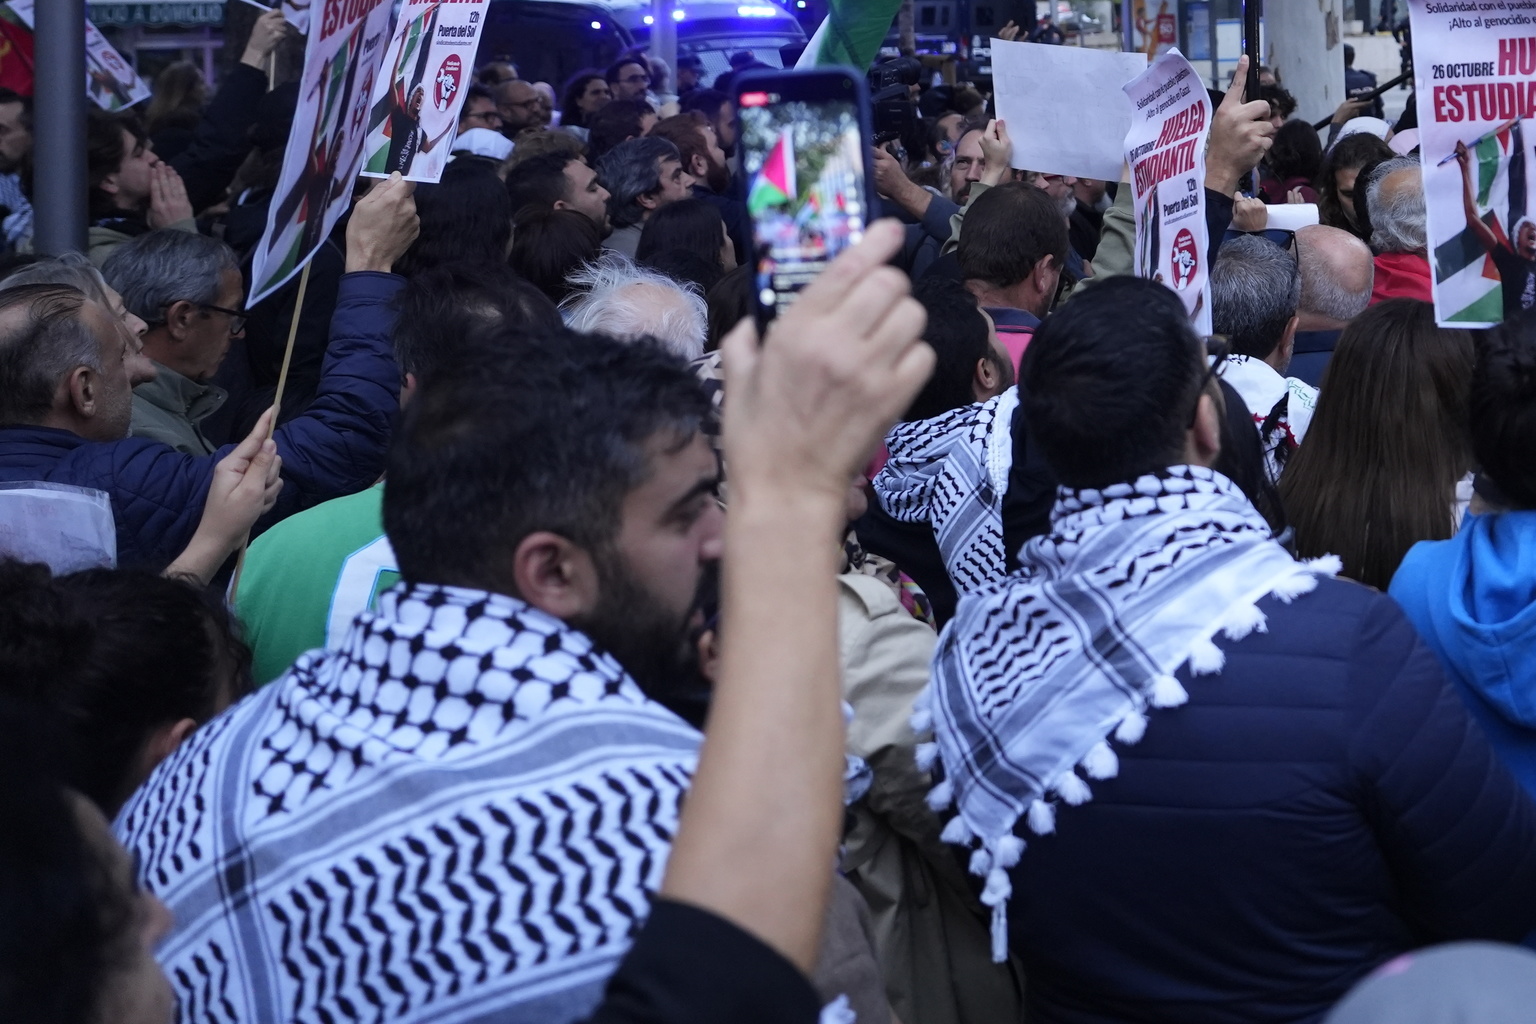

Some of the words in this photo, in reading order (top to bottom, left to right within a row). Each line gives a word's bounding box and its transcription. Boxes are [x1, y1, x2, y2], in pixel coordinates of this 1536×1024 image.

[1426, 1, 1477, 14] Solidaridad
[1479, 3, 1495, 12] con
[1498, 1, 1506, 10] el
[469, 11, 480, 23] 12h
[1449, 17, 1472, 31] ¡Alto
[1474, 16, 1482, 27] al
[1484, 14, 1530, 29] genocidio
[437, 25, 457, 37] Puerta
[458, 25, 467, 37] del
[467, 25, 477, 37] Sol
[1432, 65, 1445, 79] 26
[1446, 62, 1495, 78] OCTUBRE
[1136, 91, 1156, 111] Solidaridad
[1135, 139, 1157, 160] OCTUBRE
[1155, 99, 1205, 150] HUELGA
[1134, 137, 1198, 199] ESTUDIANTIL
[1186, 177, 1197, 192] 12h
[1163, 199, 1180, 217] Puerta
[1181, 195, 1189, 210] del
[1189, 192, 1198, 208] Sol
